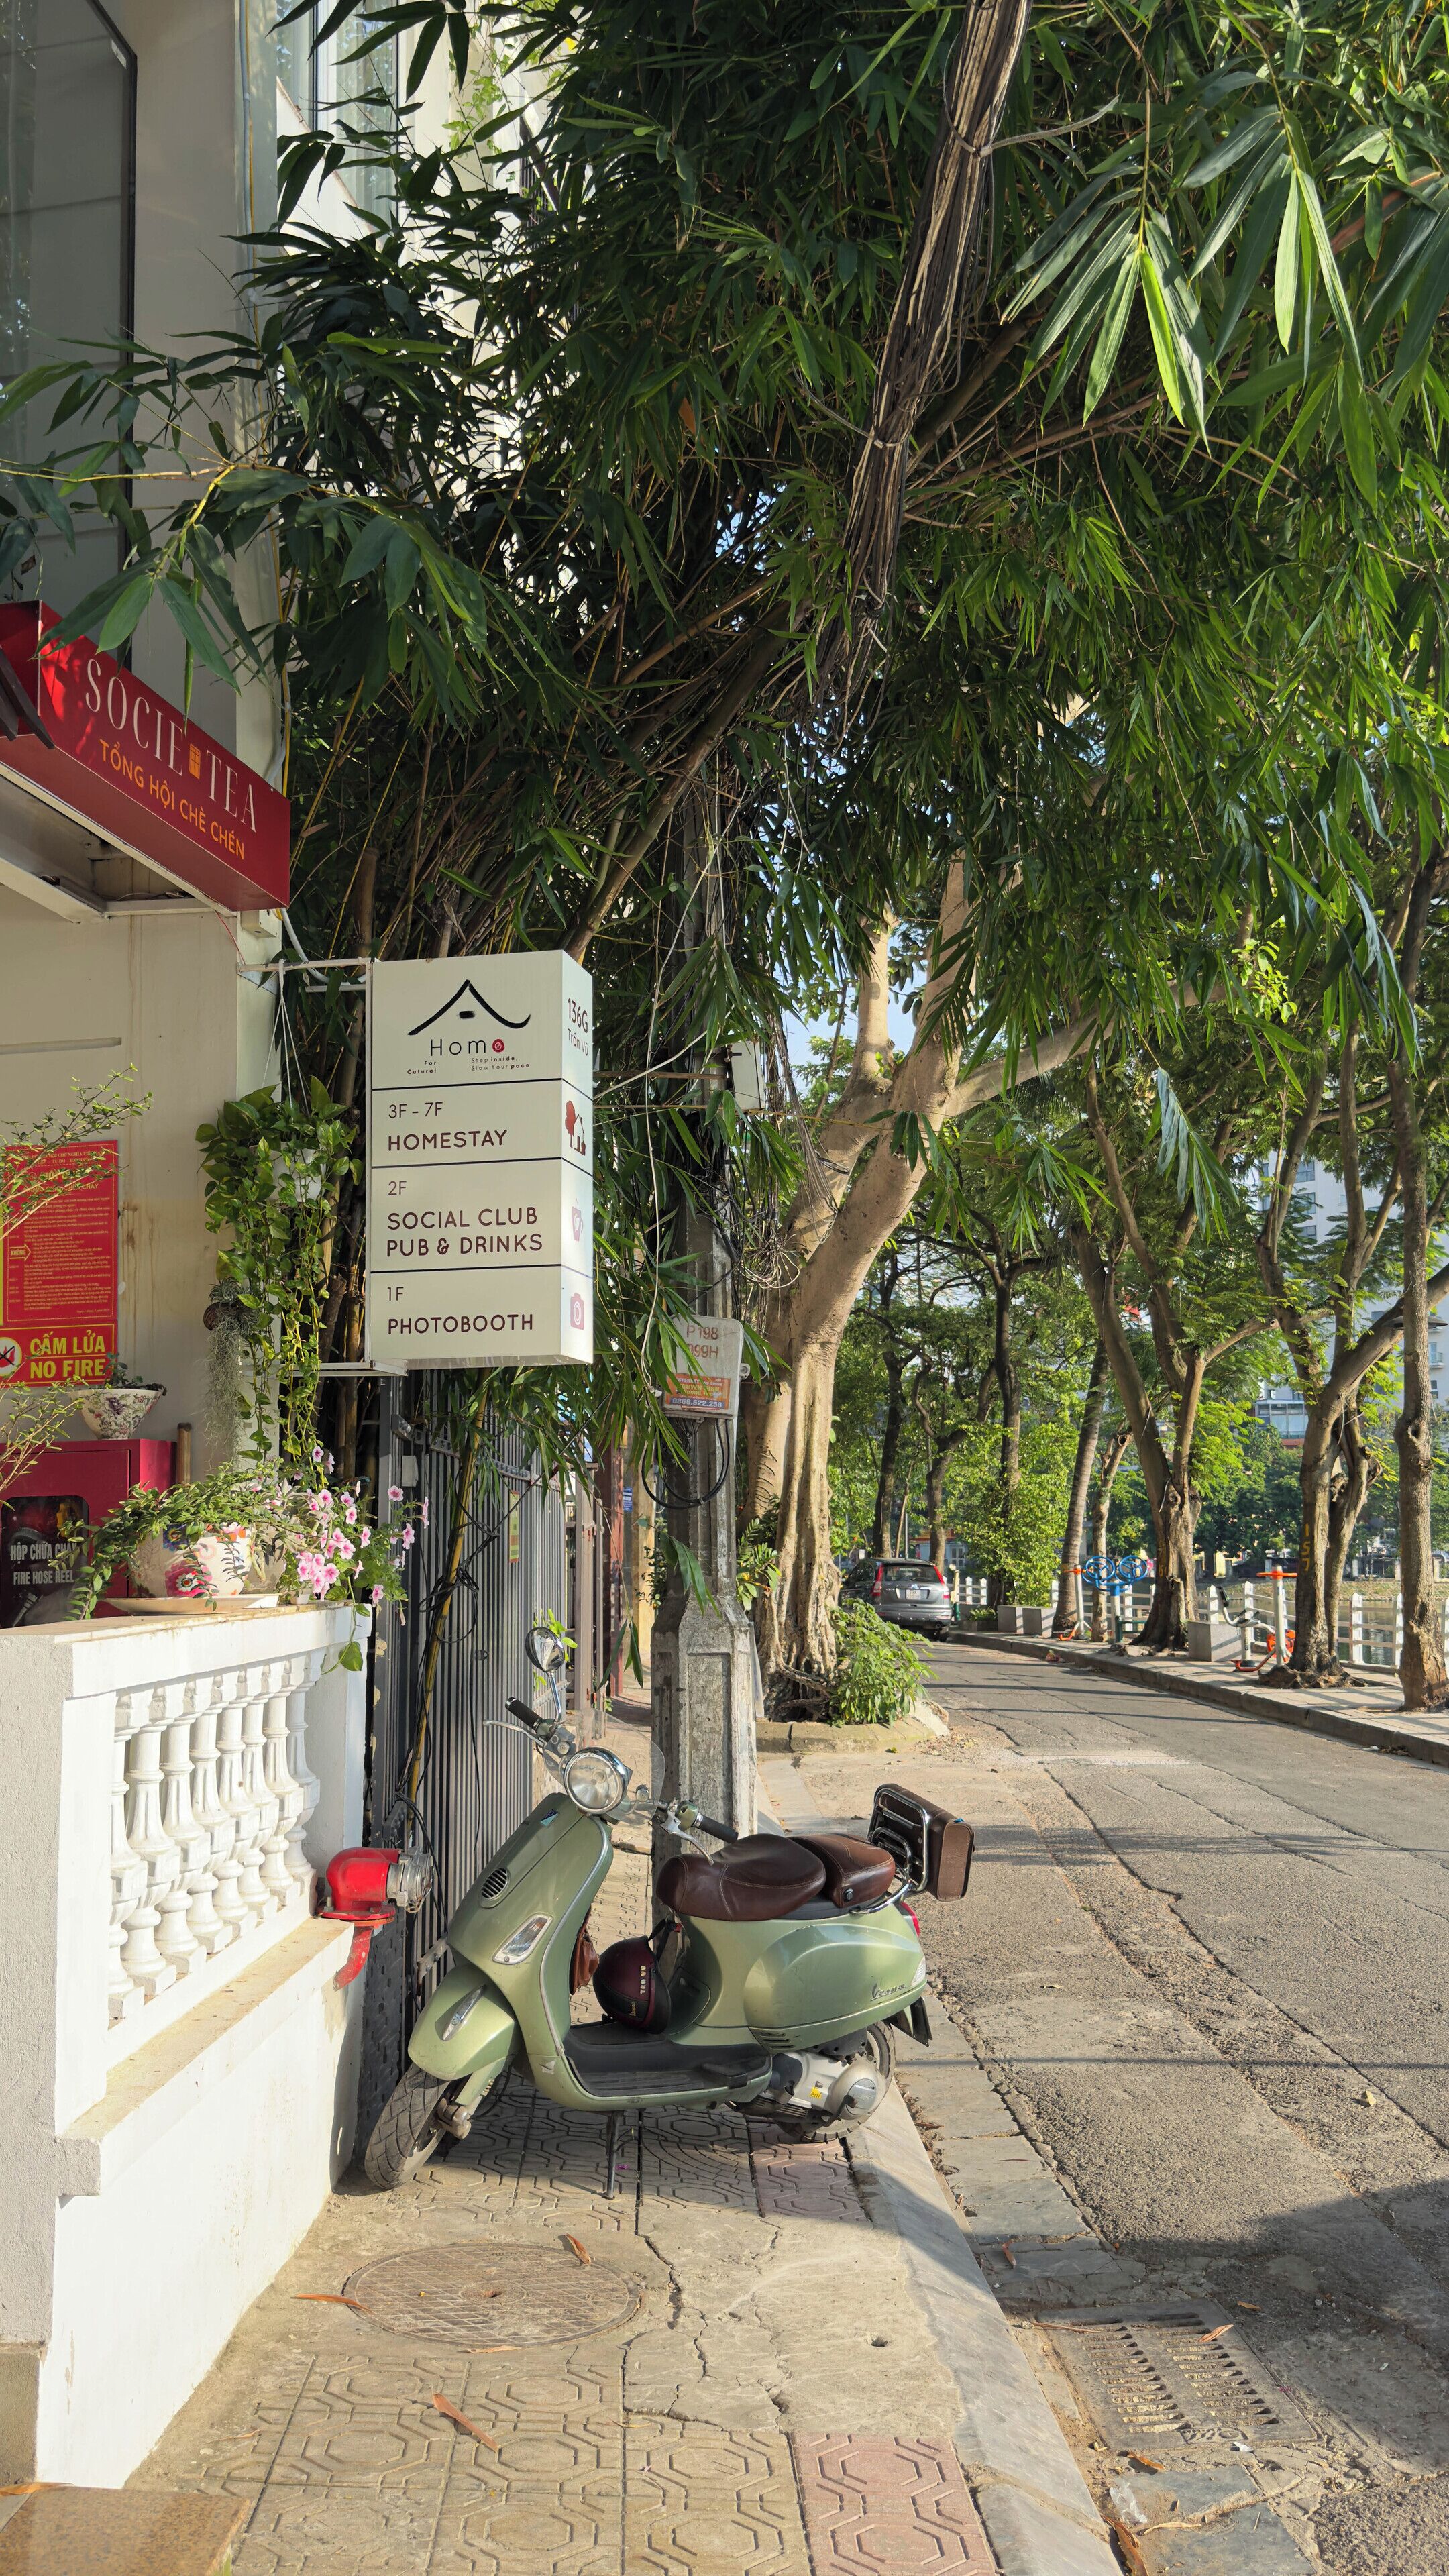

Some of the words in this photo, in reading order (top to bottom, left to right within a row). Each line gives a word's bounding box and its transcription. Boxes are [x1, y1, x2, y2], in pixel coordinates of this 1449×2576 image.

[86, 659, 183, 777] SOCIE
[206, 749, 257, 833] TEA
[99, 739, 144, 788] TỔNG
[150, 775, 174, 810] HỘI
[180, 799, 206, 834] CHÈ
[211, 821, 244, 859] CHÉN
[567, 998, 588, 1034] 136G
[388, 1104, 407, 1118] 3F
[425, 1102, 443, 1117] 7F
[388, 1129, 508, 1151] HOMESTAY
[388, 1181, 407, 1195] 2F
[387, 1210, 470, 1230] SOCIAL
[478, 1207, 537, 1226] CLUB
[386, 1238, 429, 1257] PUB
[437, 1237, 450, 1254] &
[460, 1233, 543, 1254] DRINKS
[387, 1287, 404, 1301] 1F
[388, 1313, 533, 1335] PHOTOBOOTH
[687, 1324, 696, 1338] P
[698, 1326, 718, 1340] 198
[30, 1331, 67, 1356] CẤM
[73, 1330, 105, 1354] LỬA
[30, 1360, 56, 1379] NO
[63, 1359, 105, 1377] FIRE
[10, 1542, 28, 1564] HỘP
[30, 1541, 52, 1560] CHỮA
[13, 1571, 30, 1585] FIRE
[32, 1570, 53, 1585] HOSE
[55, 1570, 74, 1583] REEL
